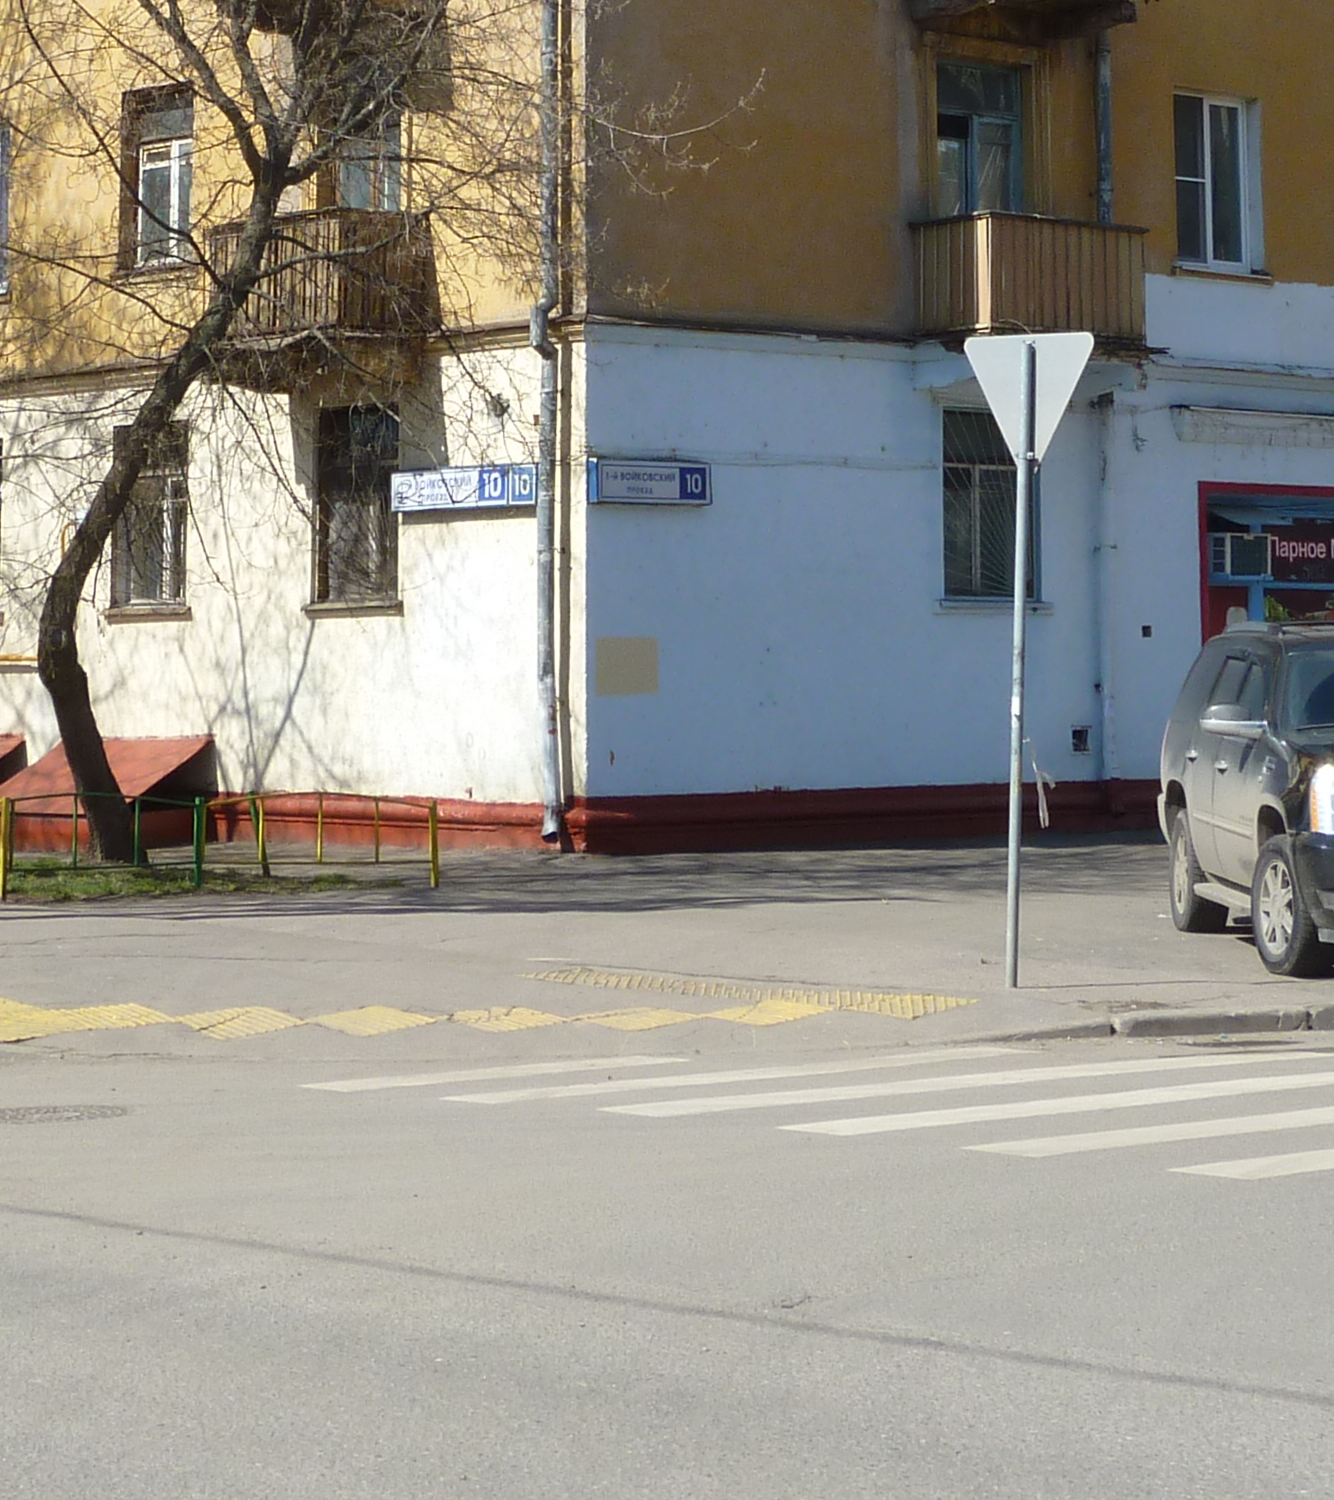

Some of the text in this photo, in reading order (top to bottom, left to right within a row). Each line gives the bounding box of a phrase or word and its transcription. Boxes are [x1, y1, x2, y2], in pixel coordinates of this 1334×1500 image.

[483, 472, 502, 498] 10
[513, 474, 530, 496] 10
[620, 471, 676, 483] ВОЙКОВСКИЙ
[685, 473, 702, 494] 10
[1270, 536, 1327, 562] Парное
